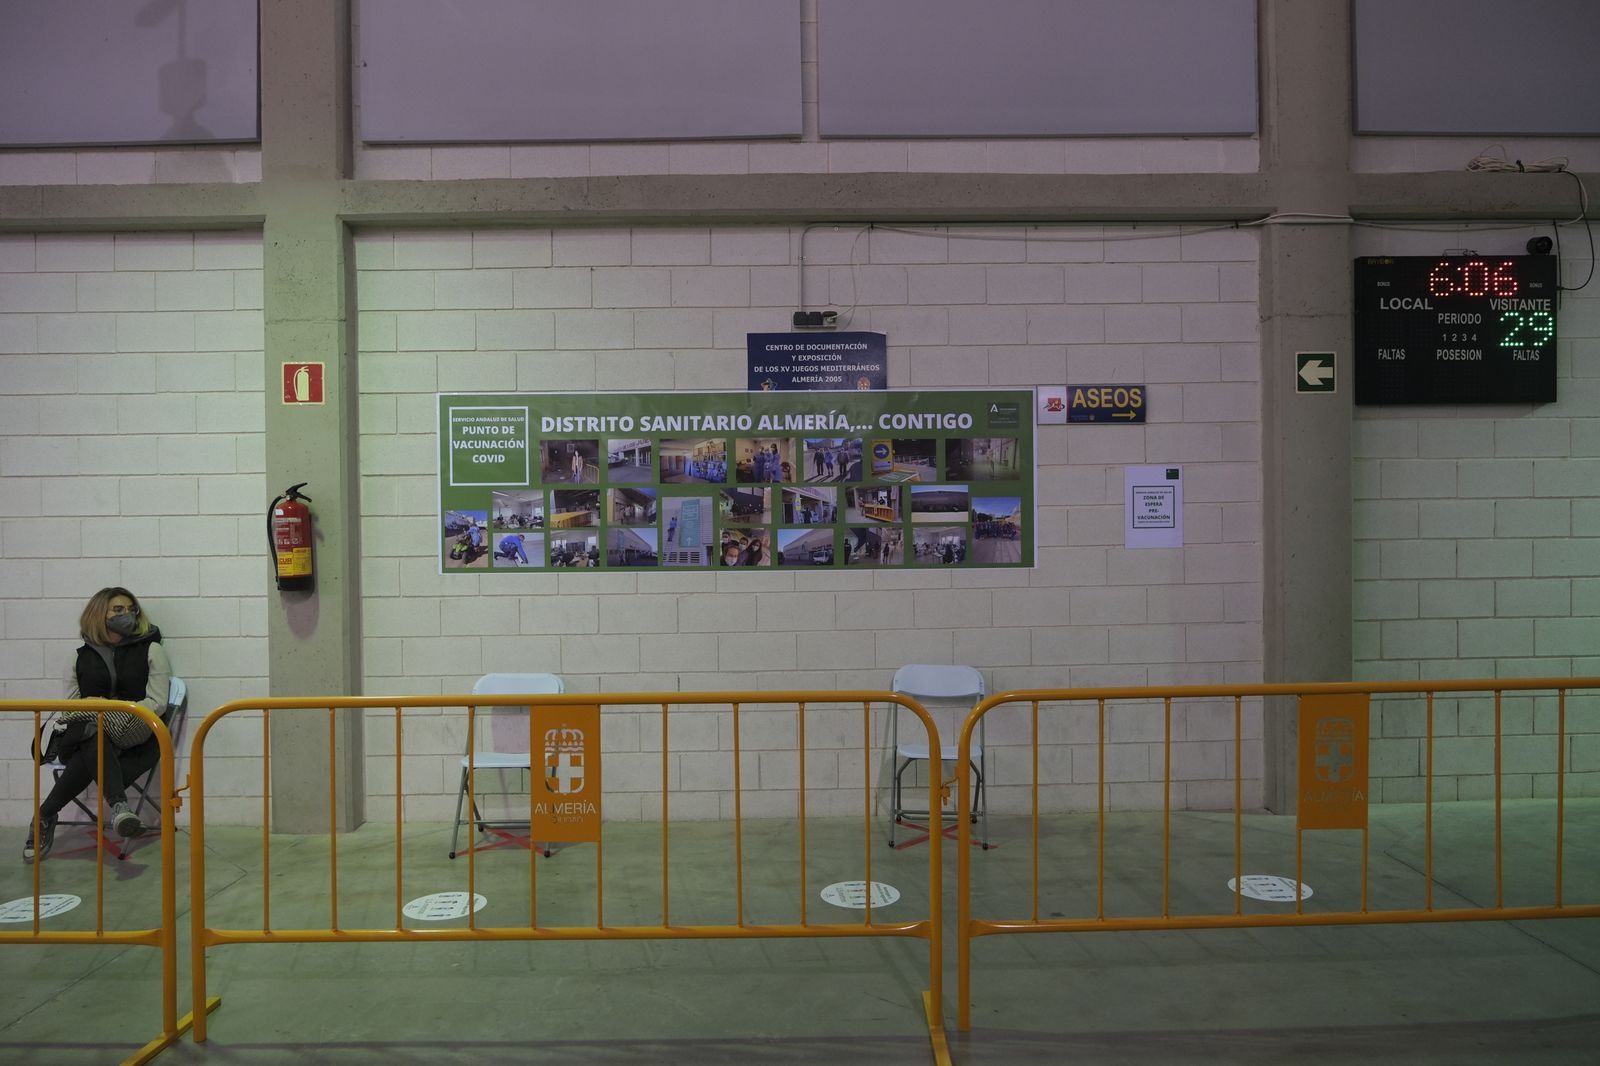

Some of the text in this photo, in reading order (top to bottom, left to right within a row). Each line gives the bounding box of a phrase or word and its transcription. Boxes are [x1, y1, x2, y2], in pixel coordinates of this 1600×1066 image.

[1430, 262, 1518, 296] 6:06
[1380, 298, 1433, 310] LOCAL
[1490, 299, 1551, 311] VISITANTE
[1438, 313, 1482, 324] PERIODO
[1500, 312, 1552, 346] 29
[1452, 334, 1457, 342] 2
[1462, 334, 1467, 342] 3
[1472, 334, 1477, 342] 4
[807, 342, 868, 350] DOCUMENTACIÓN
[798, 353, 842, 361] EXPOSICIÓN
[1378, 349, 1406, 360] FALTAS
[1437, 349, 1482, 361] POSESION
[1513, 350, 1540, 361] FALTAS
[821, 363, 880, 371] MEDITERRÁNEOS
[792, 374, 823, 383] ALMERÍA
[1072, 388, 1142, 408] ASEOS
[541, 416, 634, 432] DISTRITO
[640, 415, 752, 432] SANITARIO
[879, 413, 973, 430] CONTIGO
[462, 426, 515, 434] PUNTO DE
[453, 438, 524, 448] VACUNACIÓN
[472, 455, 505, 463] COVID
[535, 800, 596, 814] ALMERÍA
